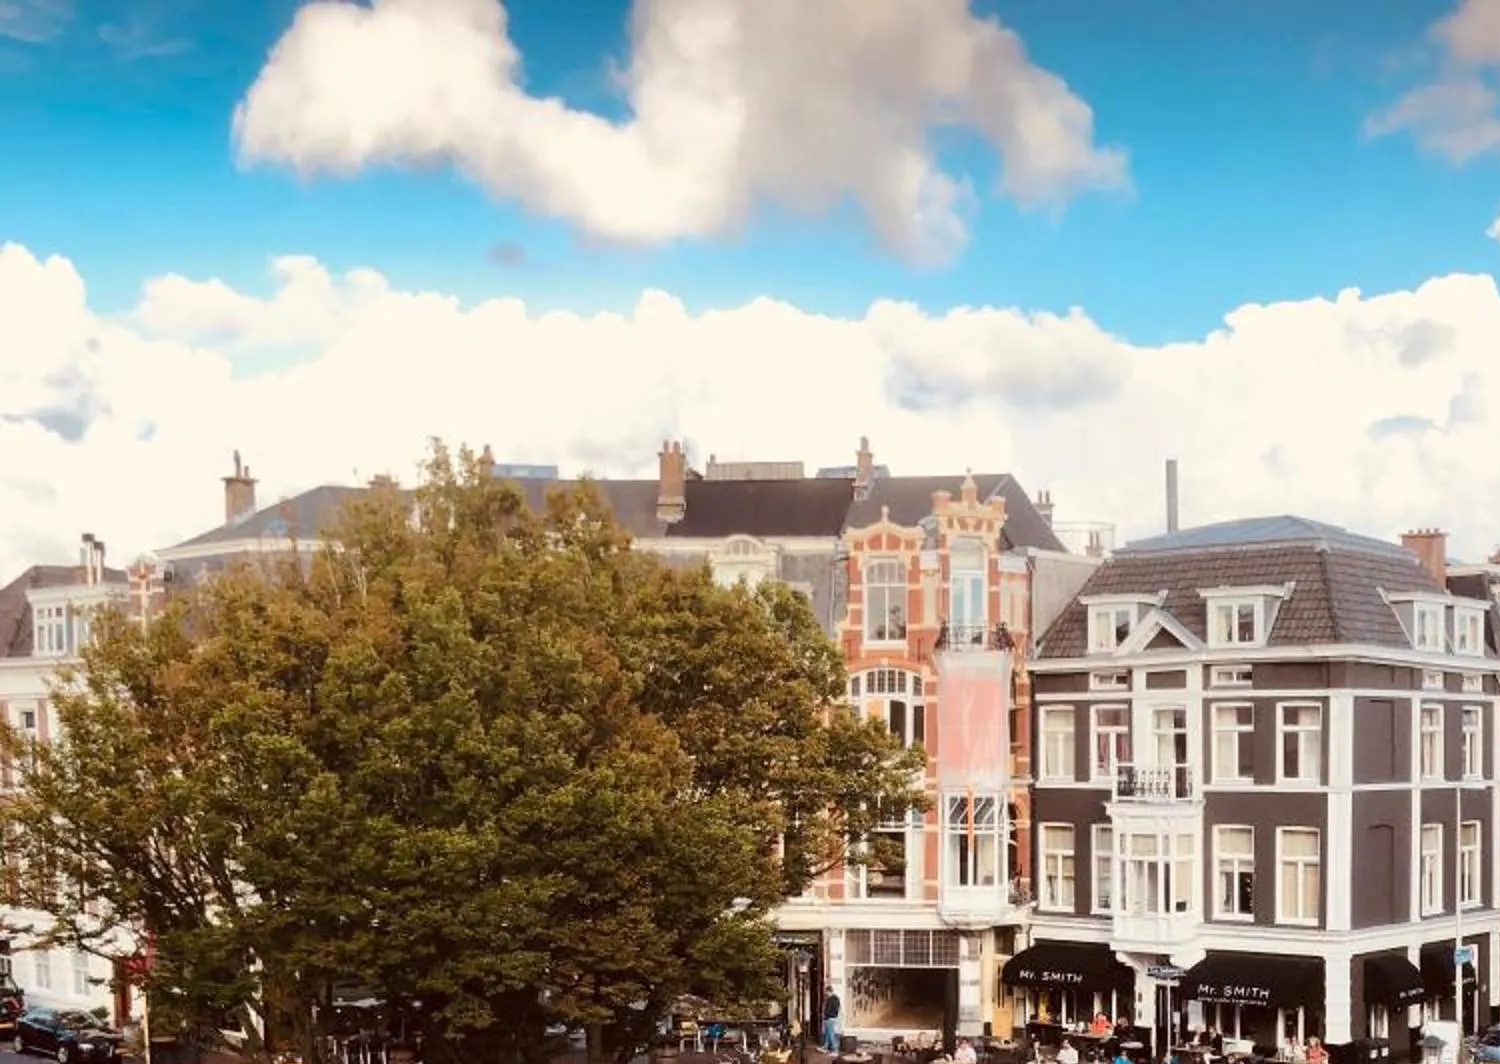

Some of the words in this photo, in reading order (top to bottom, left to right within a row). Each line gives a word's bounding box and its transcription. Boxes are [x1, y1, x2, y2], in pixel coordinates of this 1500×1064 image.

[1041, 971, 1083, 983] SMITH
[1198, 983, 1217, 995] Mr.
[1223, 985, 1270, 999] SMITH
